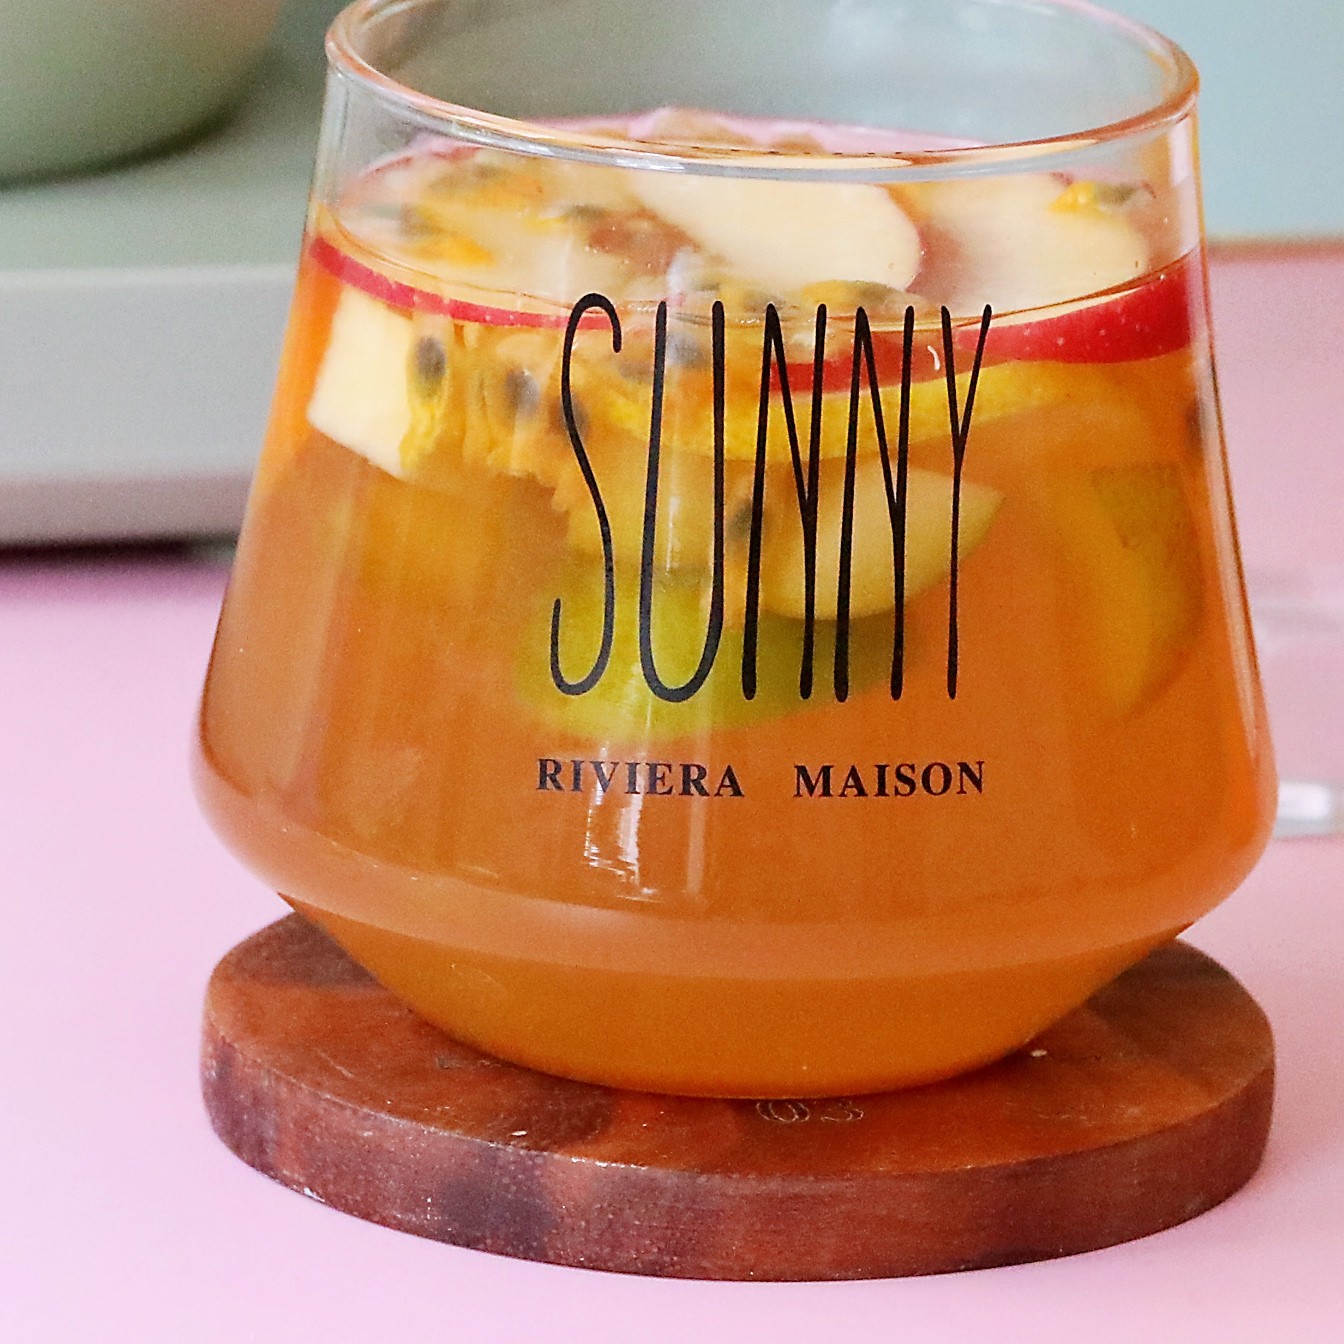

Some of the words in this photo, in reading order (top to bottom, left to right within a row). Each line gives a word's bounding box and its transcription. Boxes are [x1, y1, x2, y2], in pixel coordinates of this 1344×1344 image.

[550, 293, 992, 702] SUNNY
[537, 758, 744, 797] RIVIERA
[793, 760, 986, 798] MAISON
